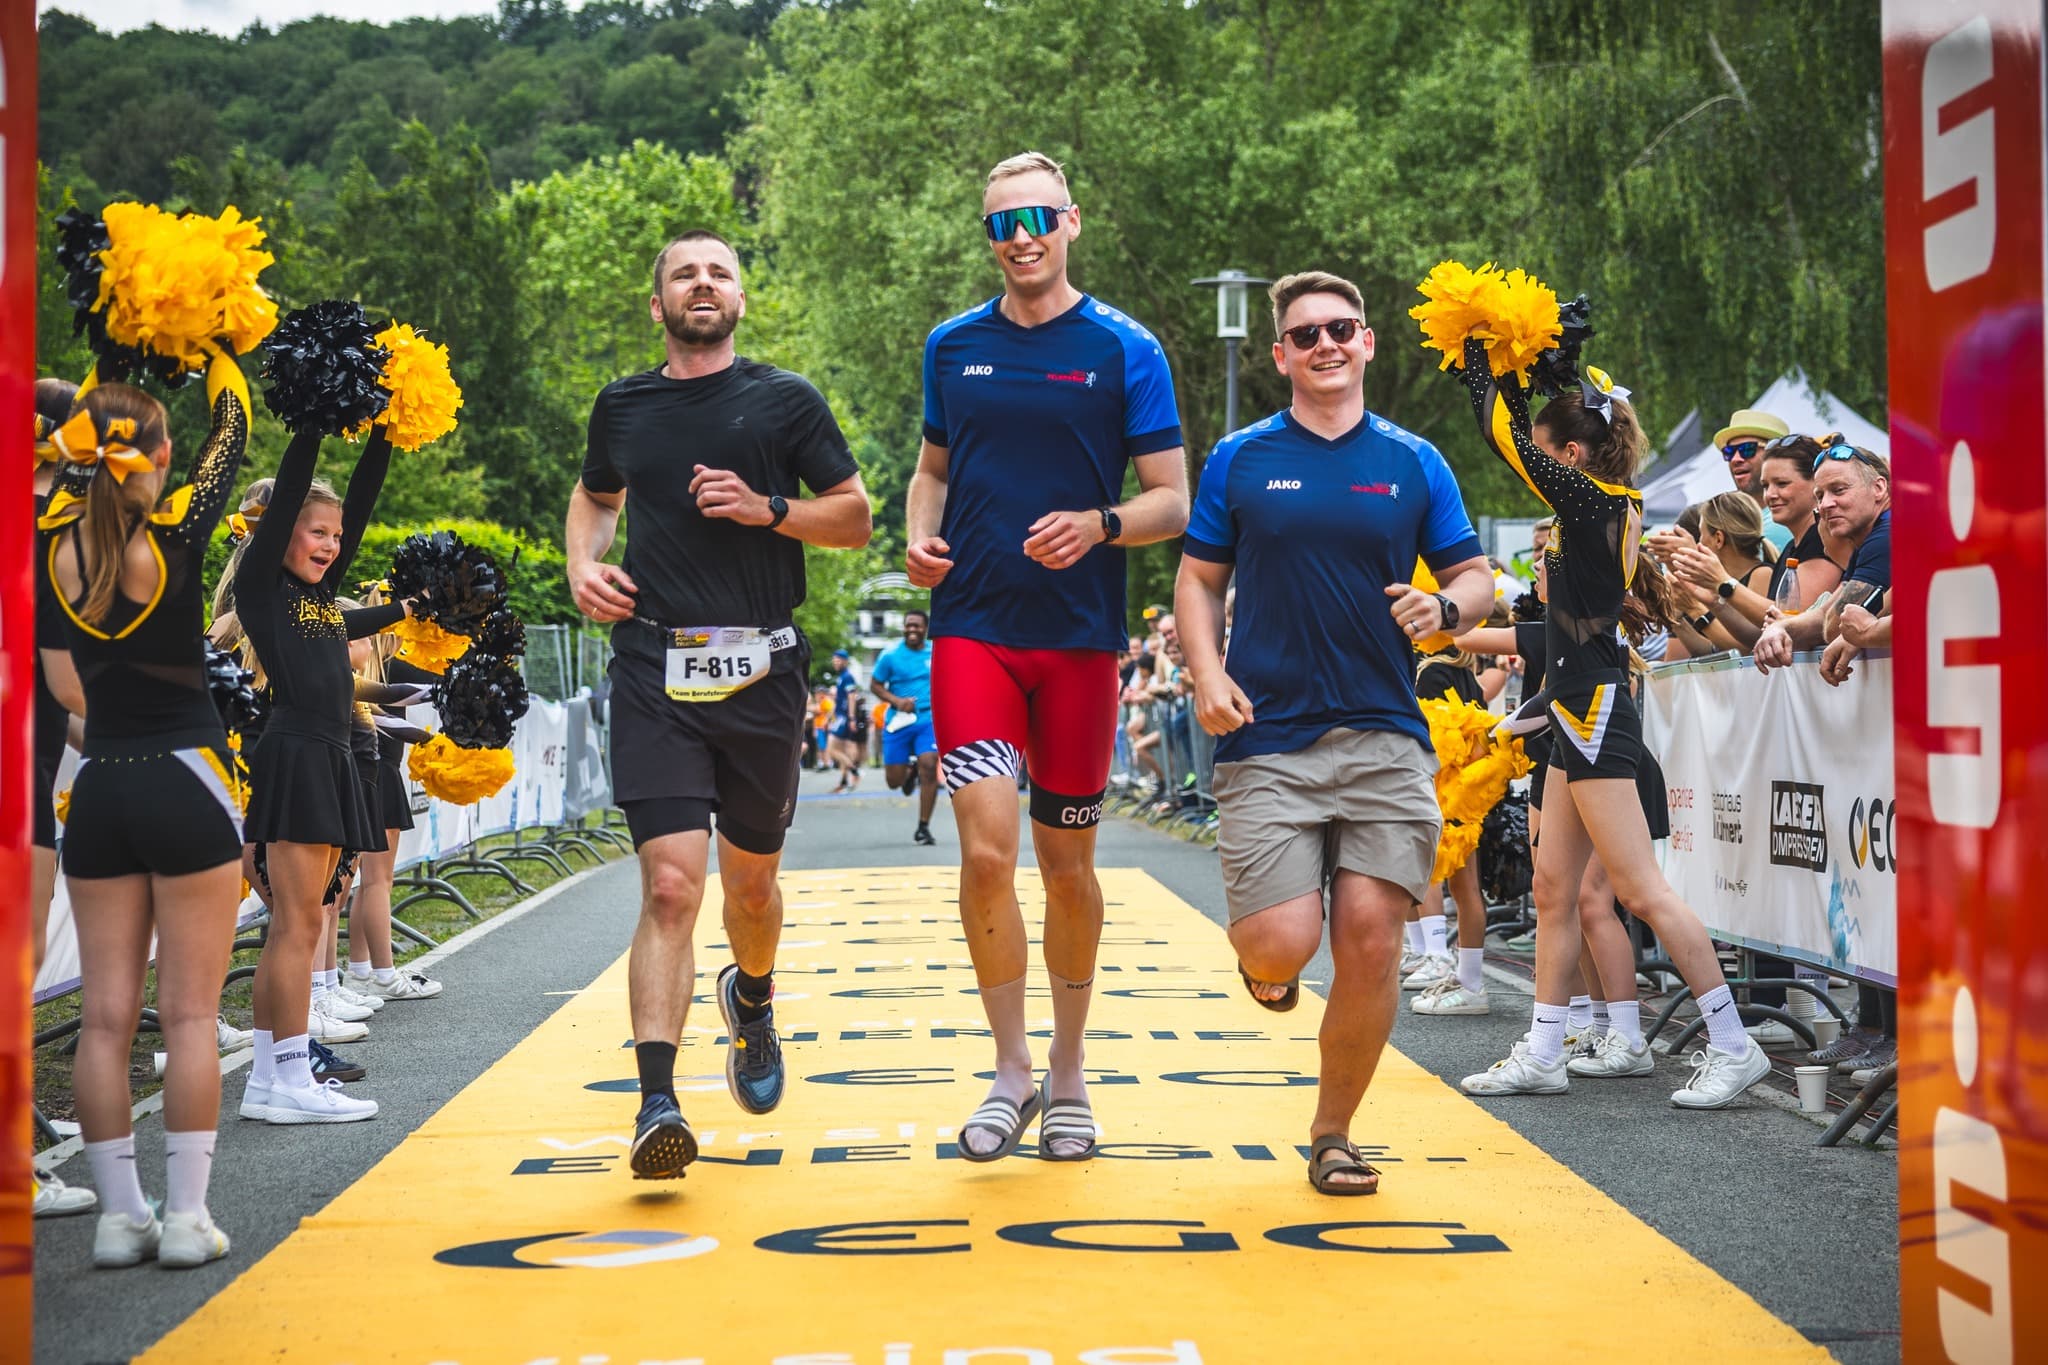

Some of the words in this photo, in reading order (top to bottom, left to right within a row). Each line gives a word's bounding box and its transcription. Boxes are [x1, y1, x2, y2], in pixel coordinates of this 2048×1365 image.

[963, 365, 993, 376] JAKO
[1266, 479, 1301, 490] JAKO
[684, 656, 752, 680] F-815
[672, 689, 690, 697] Team
[824, 1123, 1103, 1140] si
